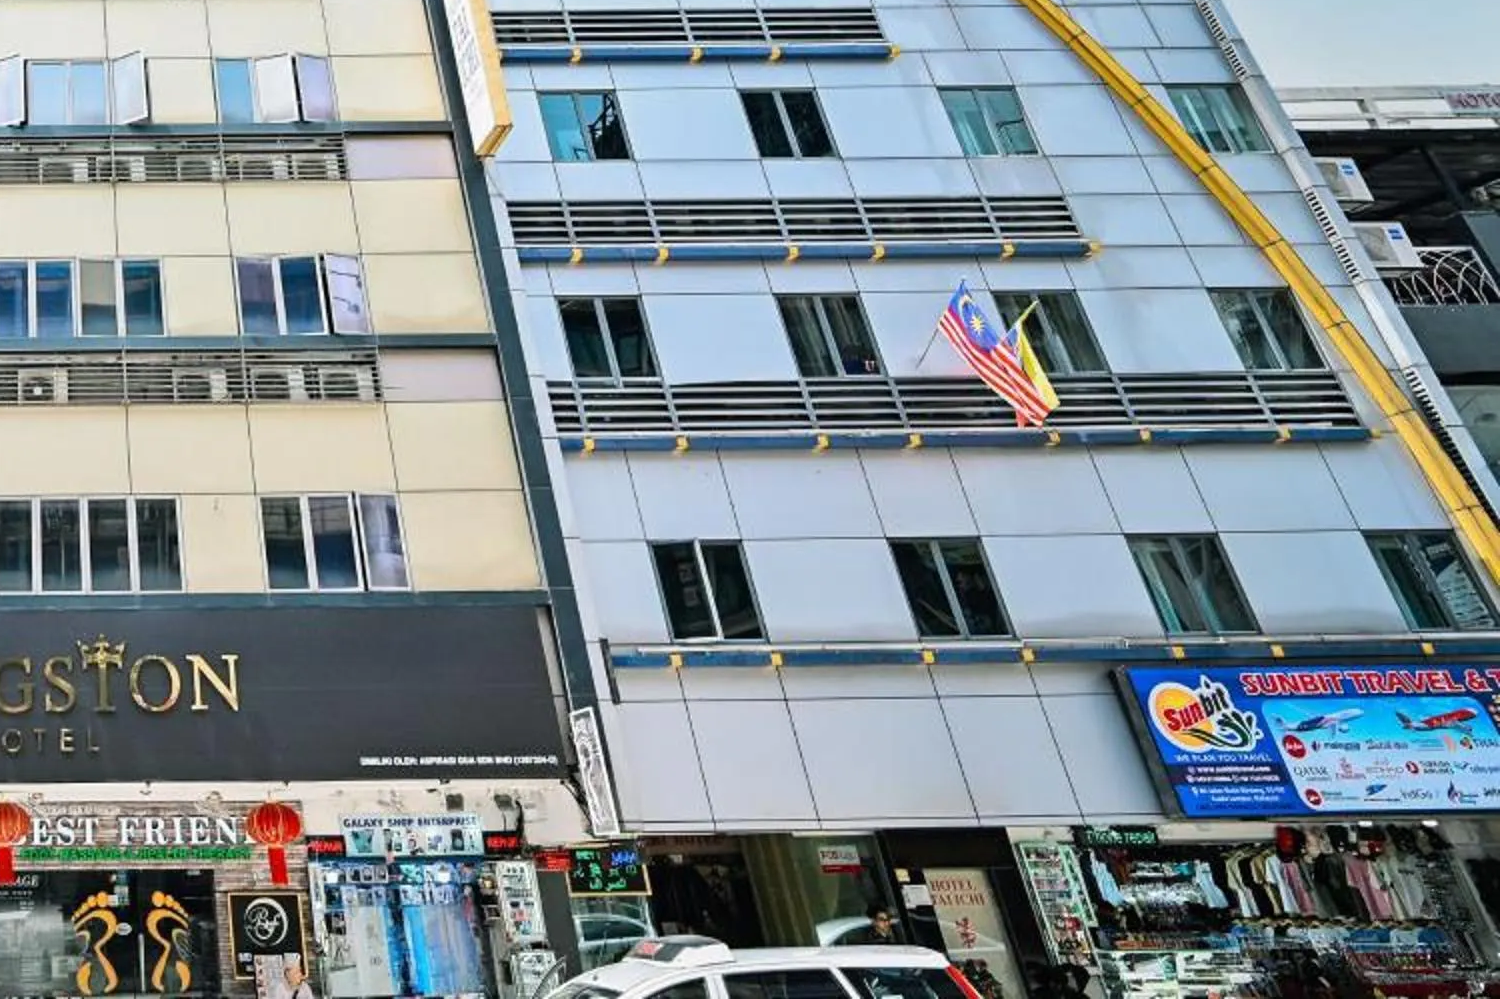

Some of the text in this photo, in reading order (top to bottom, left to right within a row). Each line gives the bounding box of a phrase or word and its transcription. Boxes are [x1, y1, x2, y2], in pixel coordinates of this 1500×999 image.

[1240, 672, 1345, 695] SUNBIT
[1345, 669, 1465, 694] TRAVEL
[1464, 668, 1487, 692] &
[1163, 687, 1229, 732] Sunbit
[11, 815, 258, 847] EST FRIEN
[343, 816, 384, 828] GALAXY
[387, 816, 415, 827] SHOP
